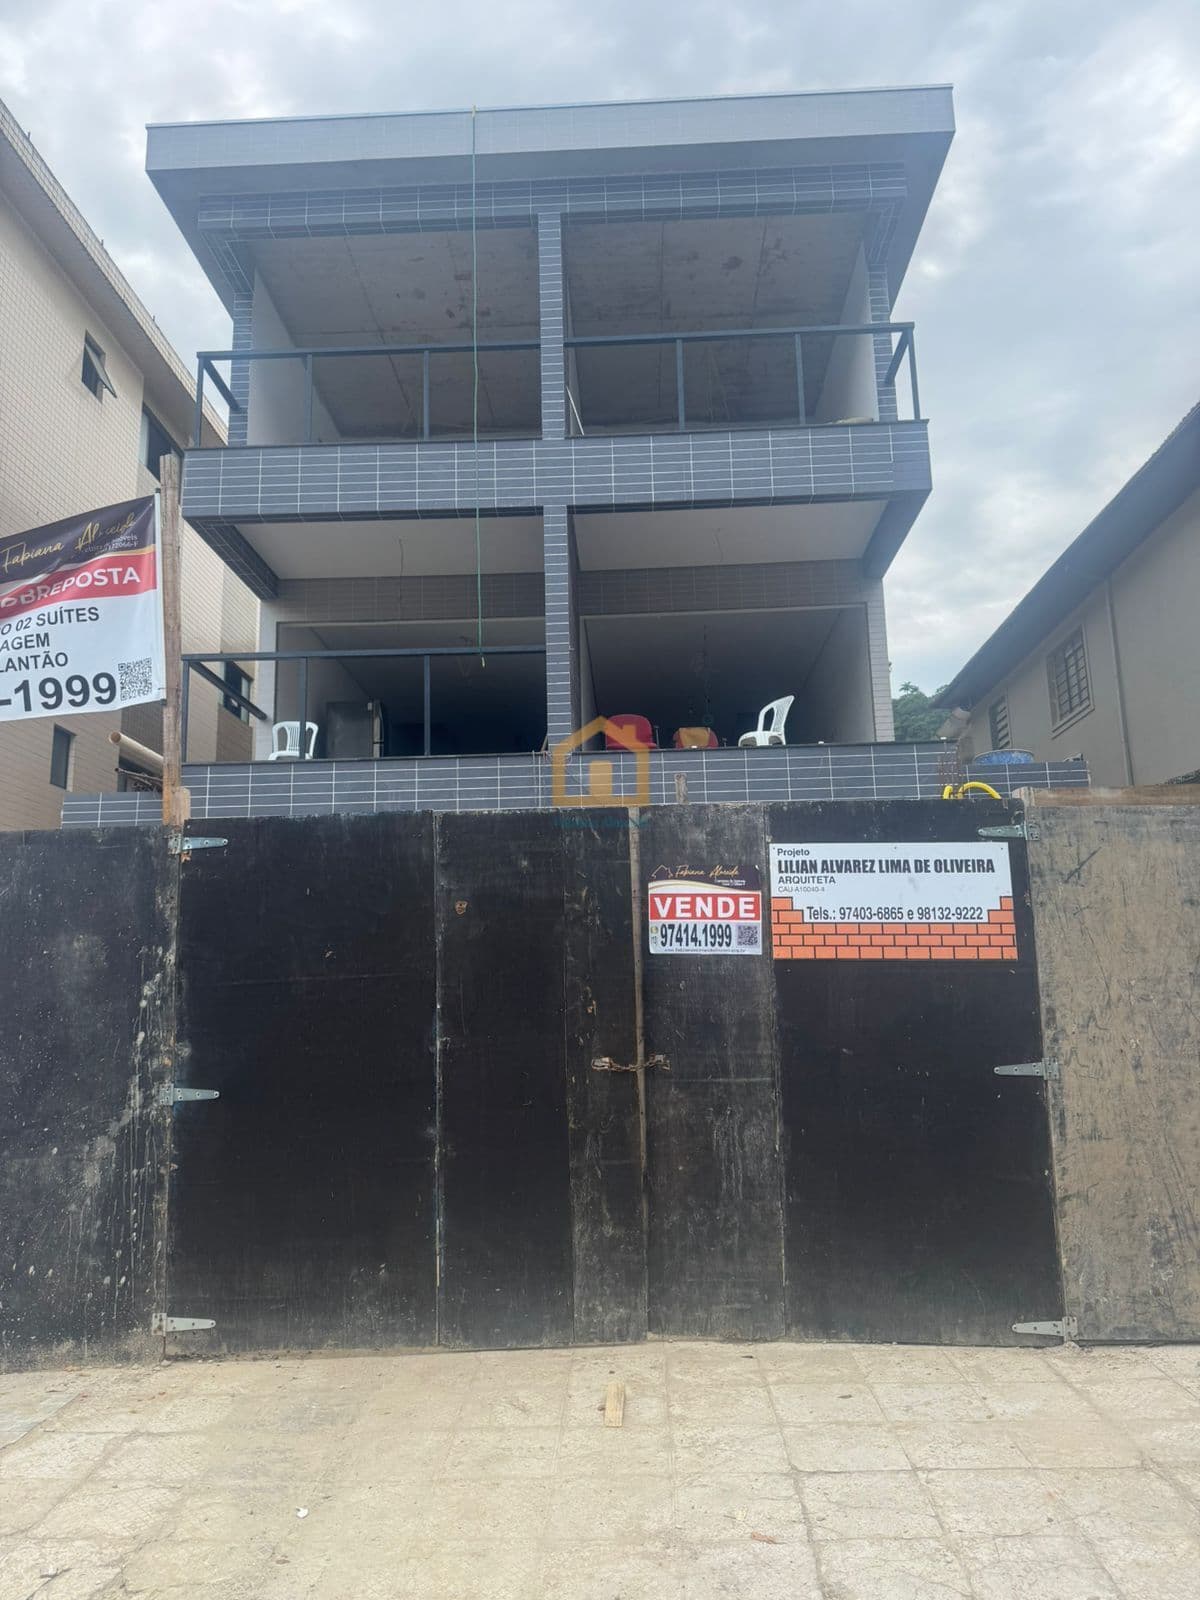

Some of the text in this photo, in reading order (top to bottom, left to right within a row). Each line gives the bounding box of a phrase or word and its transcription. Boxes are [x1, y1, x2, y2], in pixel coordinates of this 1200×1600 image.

[15, 617, 32, 632] 02
[36, 606, 100, 626] SUÍTES
[777, 848, 810, 857] Projeto
[778, 858, 995, 874] LILIAN ALVAREZ LIMA DE OLIVEIRA
[778, 875, 836, 885] ARQUITETA
[654, 896, 756, 918] VENDE
[806, 906, 984, 921] Tels.: 97403-6865 e 98132-9222
[660, 923, 732, 947] 97414.1999
